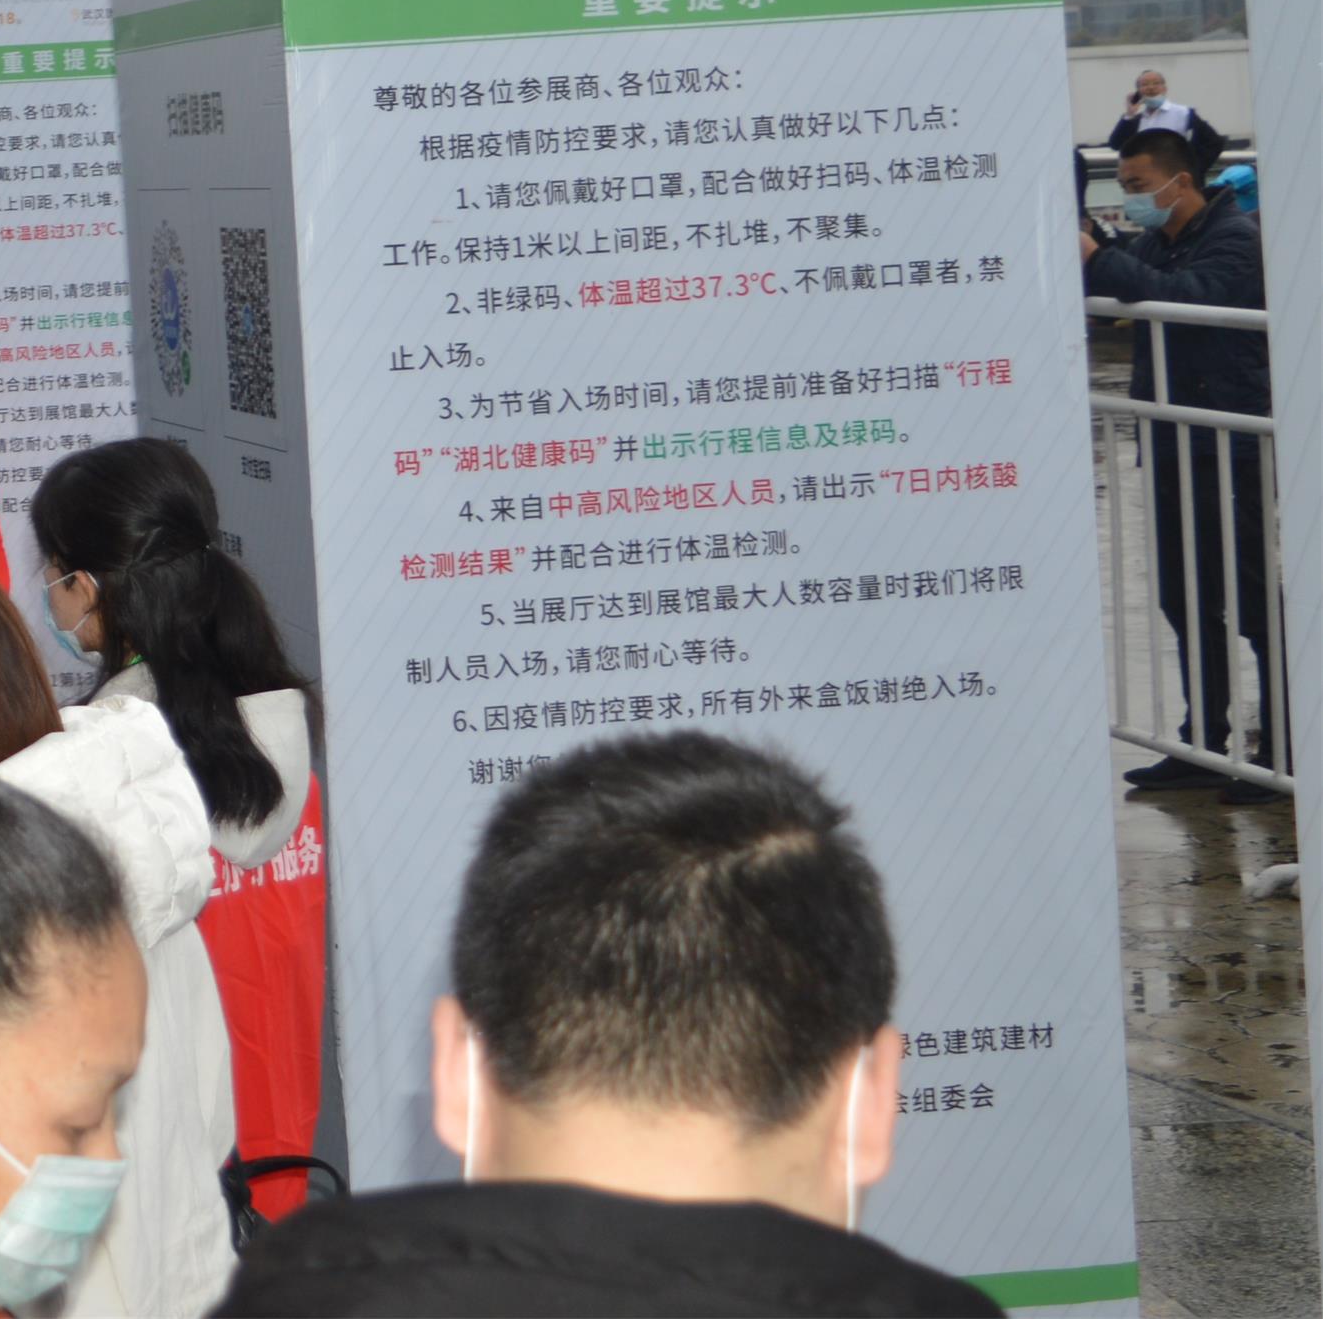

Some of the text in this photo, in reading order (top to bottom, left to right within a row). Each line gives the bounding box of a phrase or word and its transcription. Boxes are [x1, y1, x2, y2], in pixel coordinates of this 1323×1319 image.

[1, 47, 116, 76] 重要提示
[389, 341, 488, 372] 止入场。
